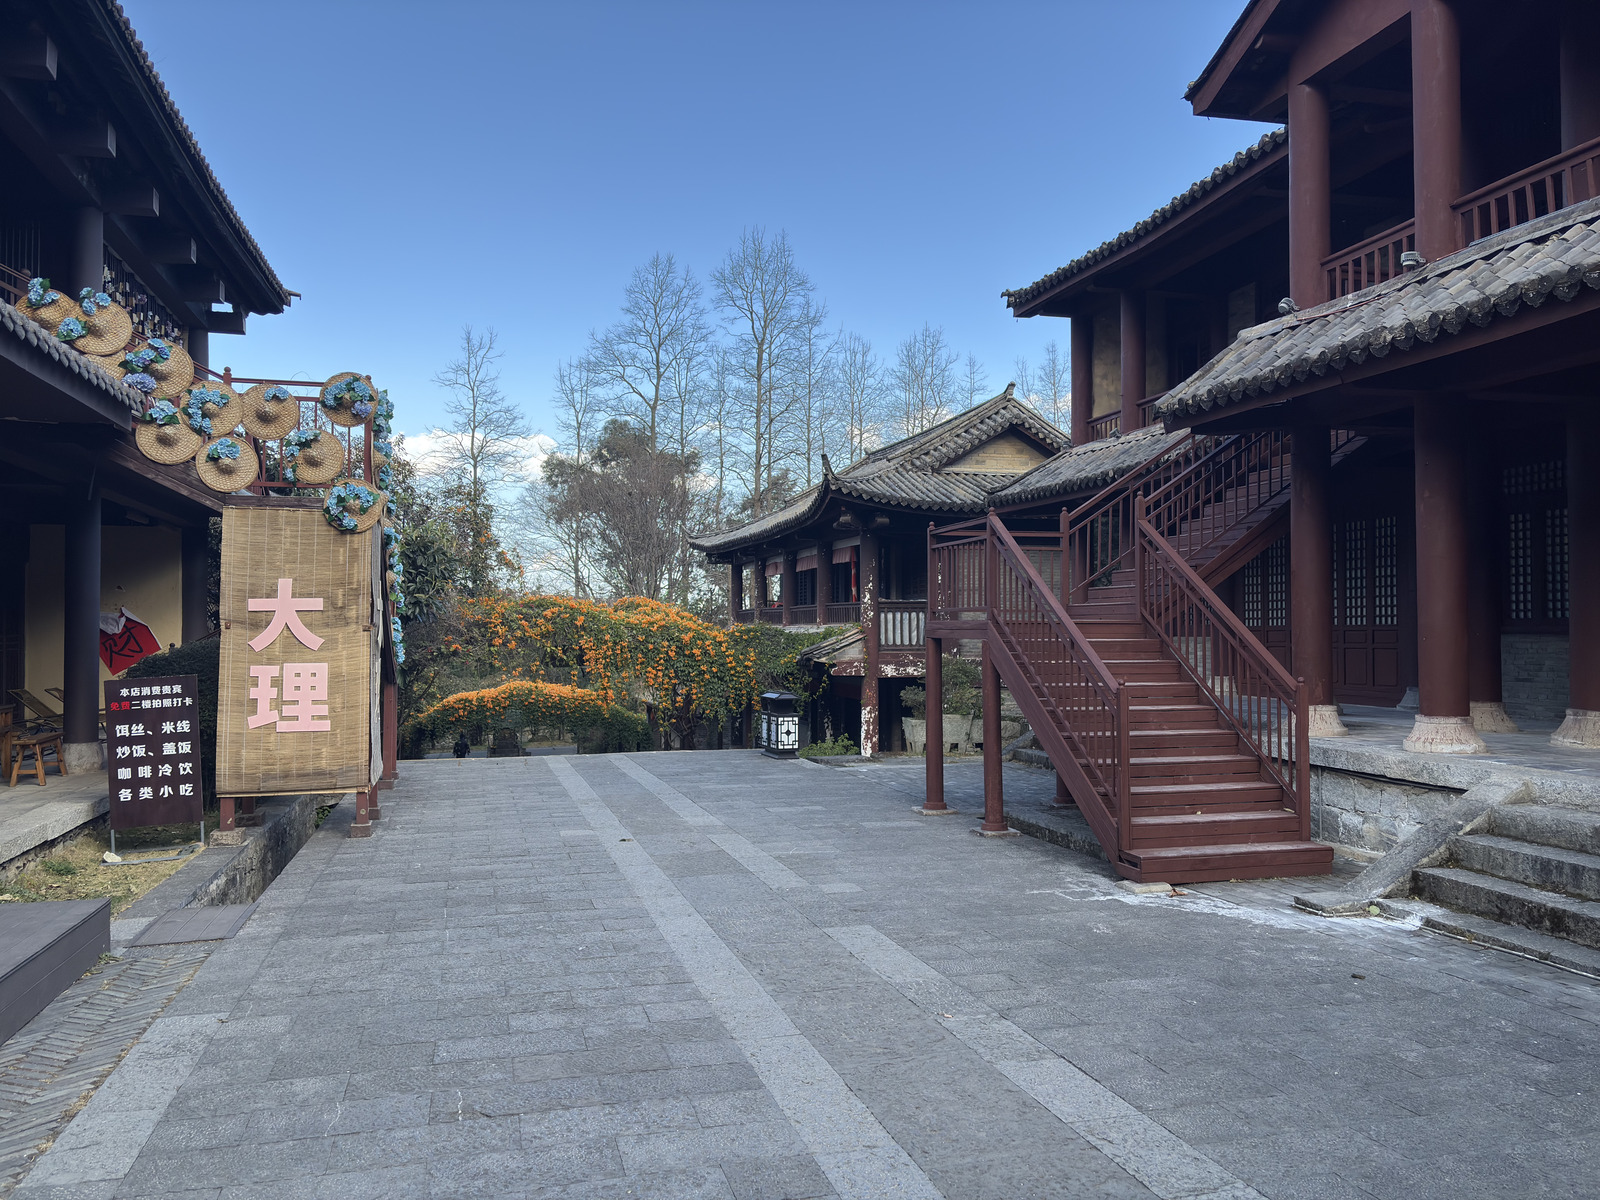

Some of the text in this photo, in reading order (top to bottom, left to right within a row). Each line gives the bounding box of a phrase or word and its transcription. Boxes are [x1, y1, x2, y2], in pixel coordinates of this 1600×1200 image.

[247, 578, 331, 733] 大理
[119, 684, 183, 698] 本店消费贵宾
[110, 697, 193, 711] 免费二楼拍照打卡
